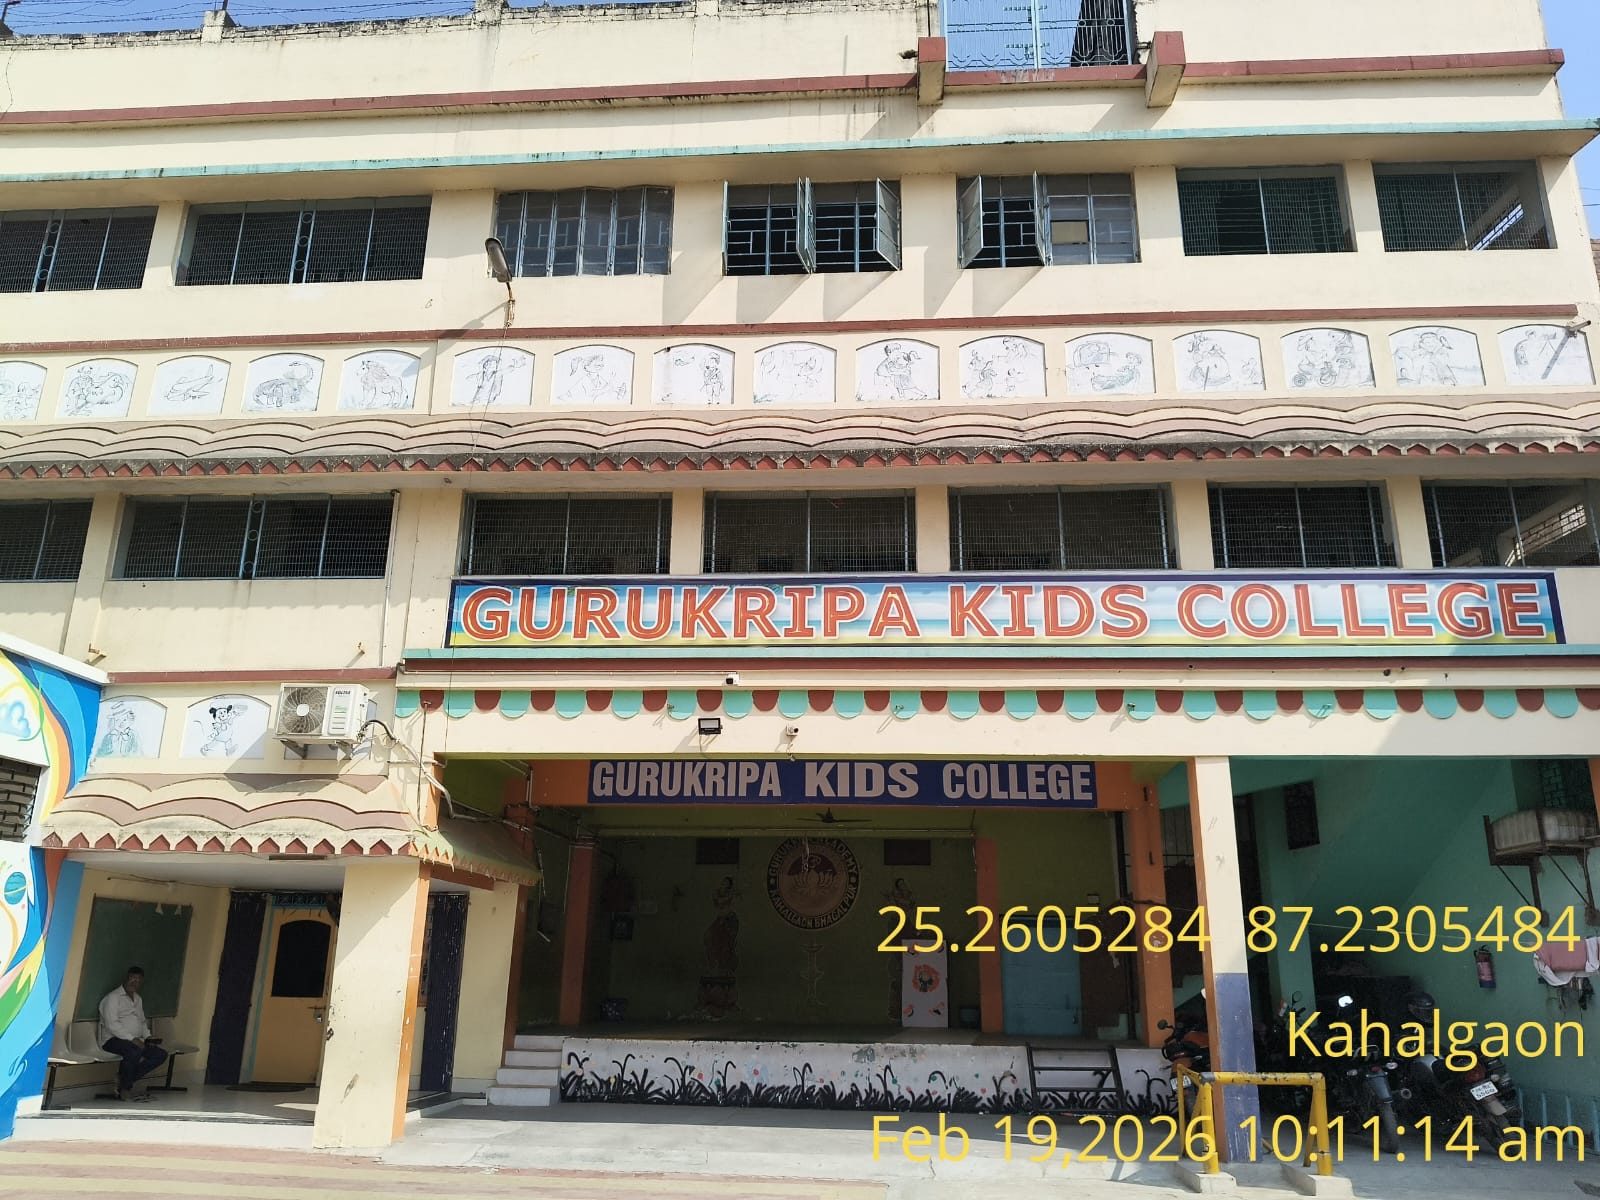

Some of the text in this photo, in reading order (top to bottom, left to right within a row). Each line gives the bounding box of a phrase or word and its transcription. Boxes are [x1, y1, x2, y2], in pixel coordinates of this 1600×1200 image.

[461, 581, 1547, 641] GURUKRIPA KIDS COLLEGE
[592, 761, 1093, 800] GURUKRIPA KIDS COLLEGE
[814, 886, 857, 929] BHAGALPUR
